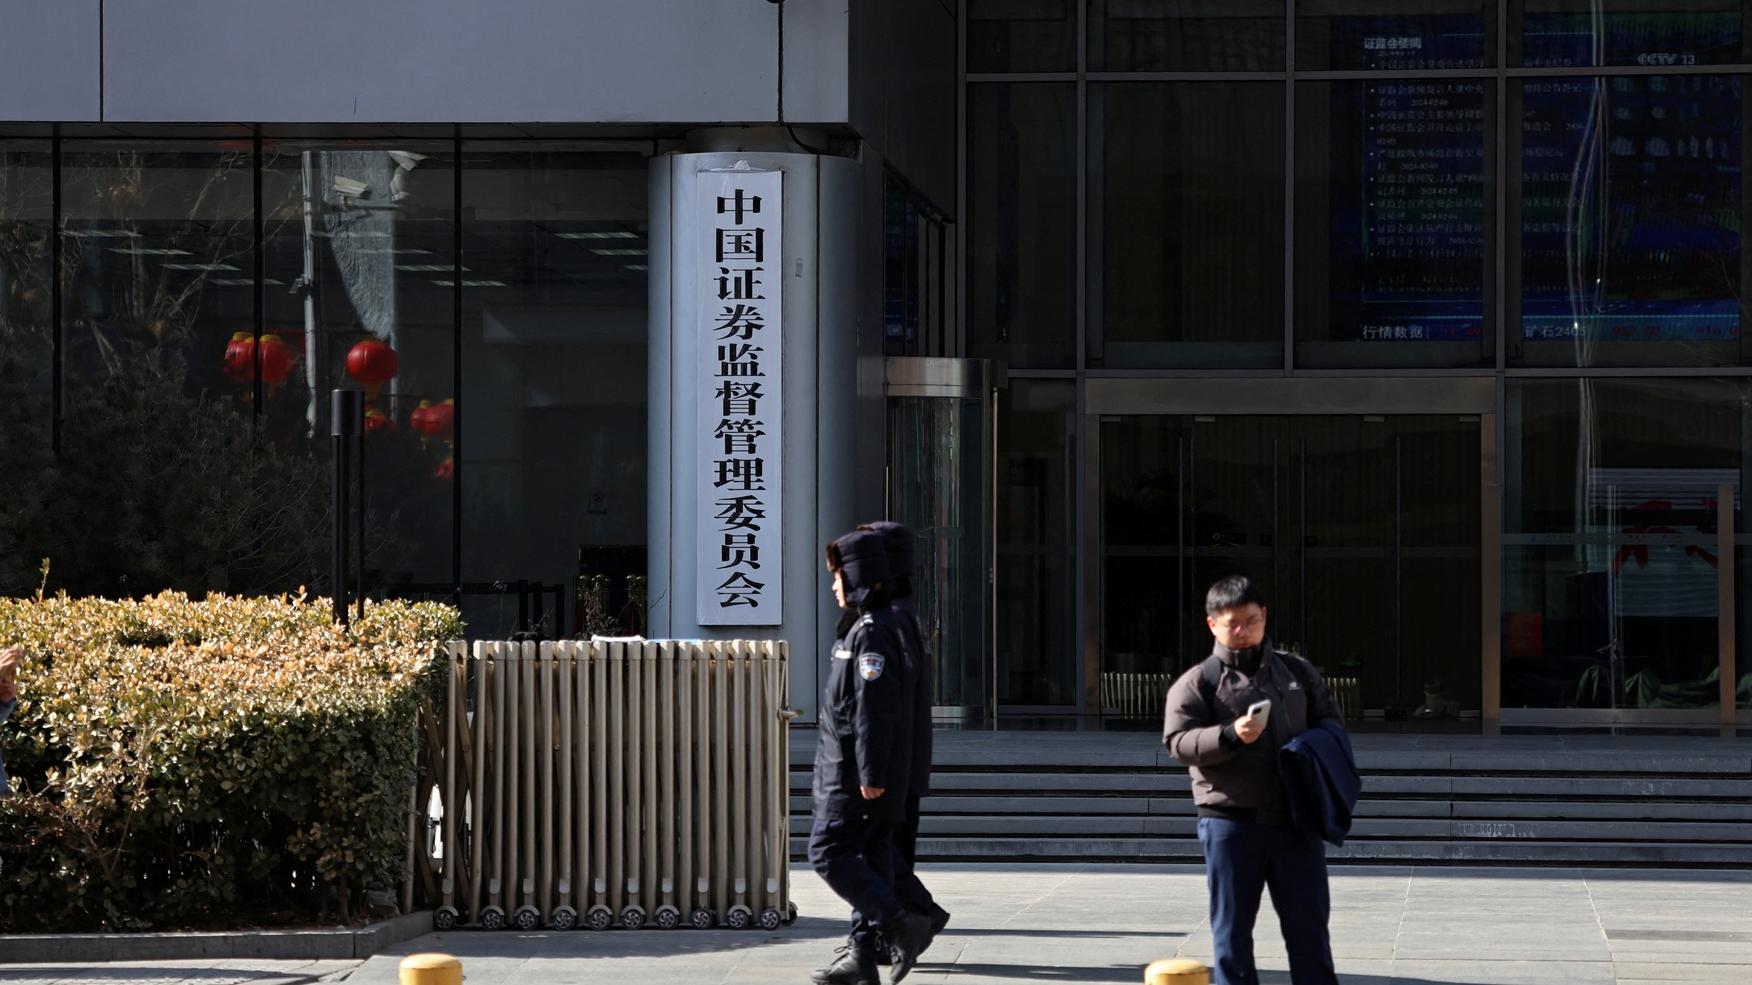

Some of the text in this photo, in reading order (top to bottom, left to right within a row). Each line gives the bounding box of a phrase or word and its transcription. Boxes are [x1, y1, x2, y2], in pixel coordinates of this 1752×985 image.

[1637, 52, 1696, 65] CCTV 13
[1362, 325, 1424, 340] 行情数据
[713, 188, 766, 608] 中国证券监督管理委员会
